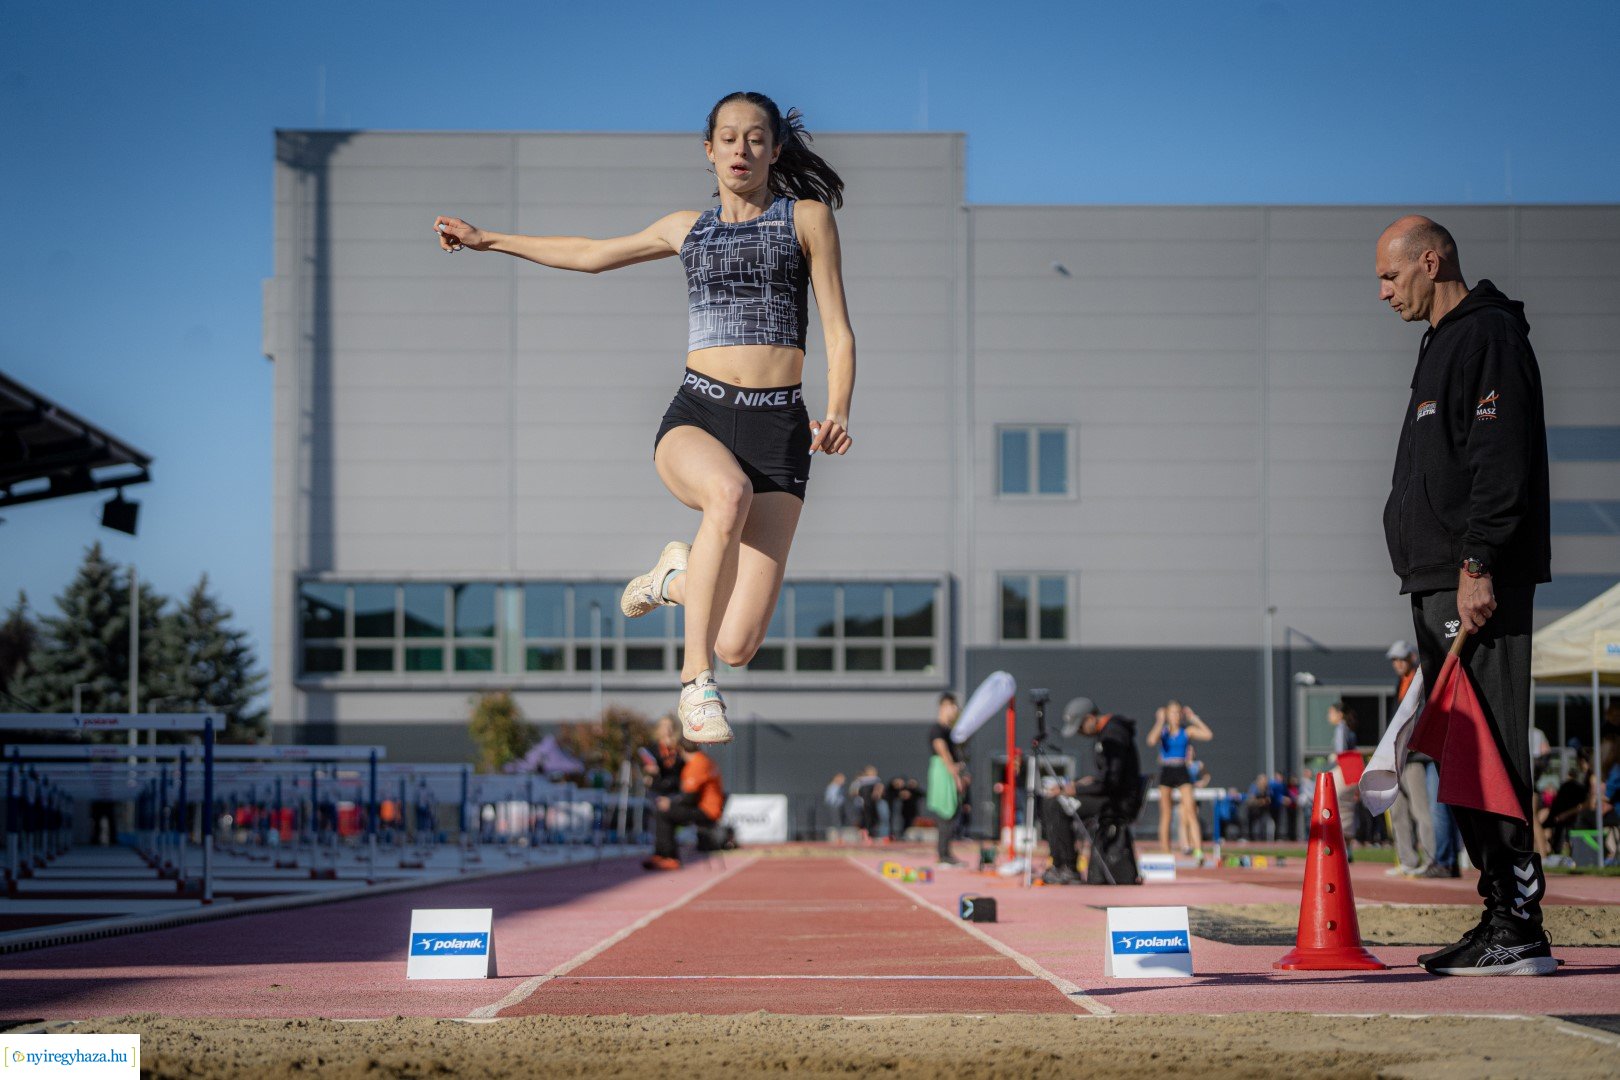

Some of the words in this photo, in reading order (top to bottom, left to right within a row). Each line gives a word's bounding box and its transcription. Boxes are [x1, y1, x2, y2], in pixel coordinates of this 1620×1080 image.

[683, 372, 726, 399] PRO
[734, 390, 788, 407] NIKE
[791, 388, 803, 404] P
[1476, 407, 1497, 416] MASZ
[433, 937, 483, 951] polanik
[1135, 935, 1183, 950] polanik
